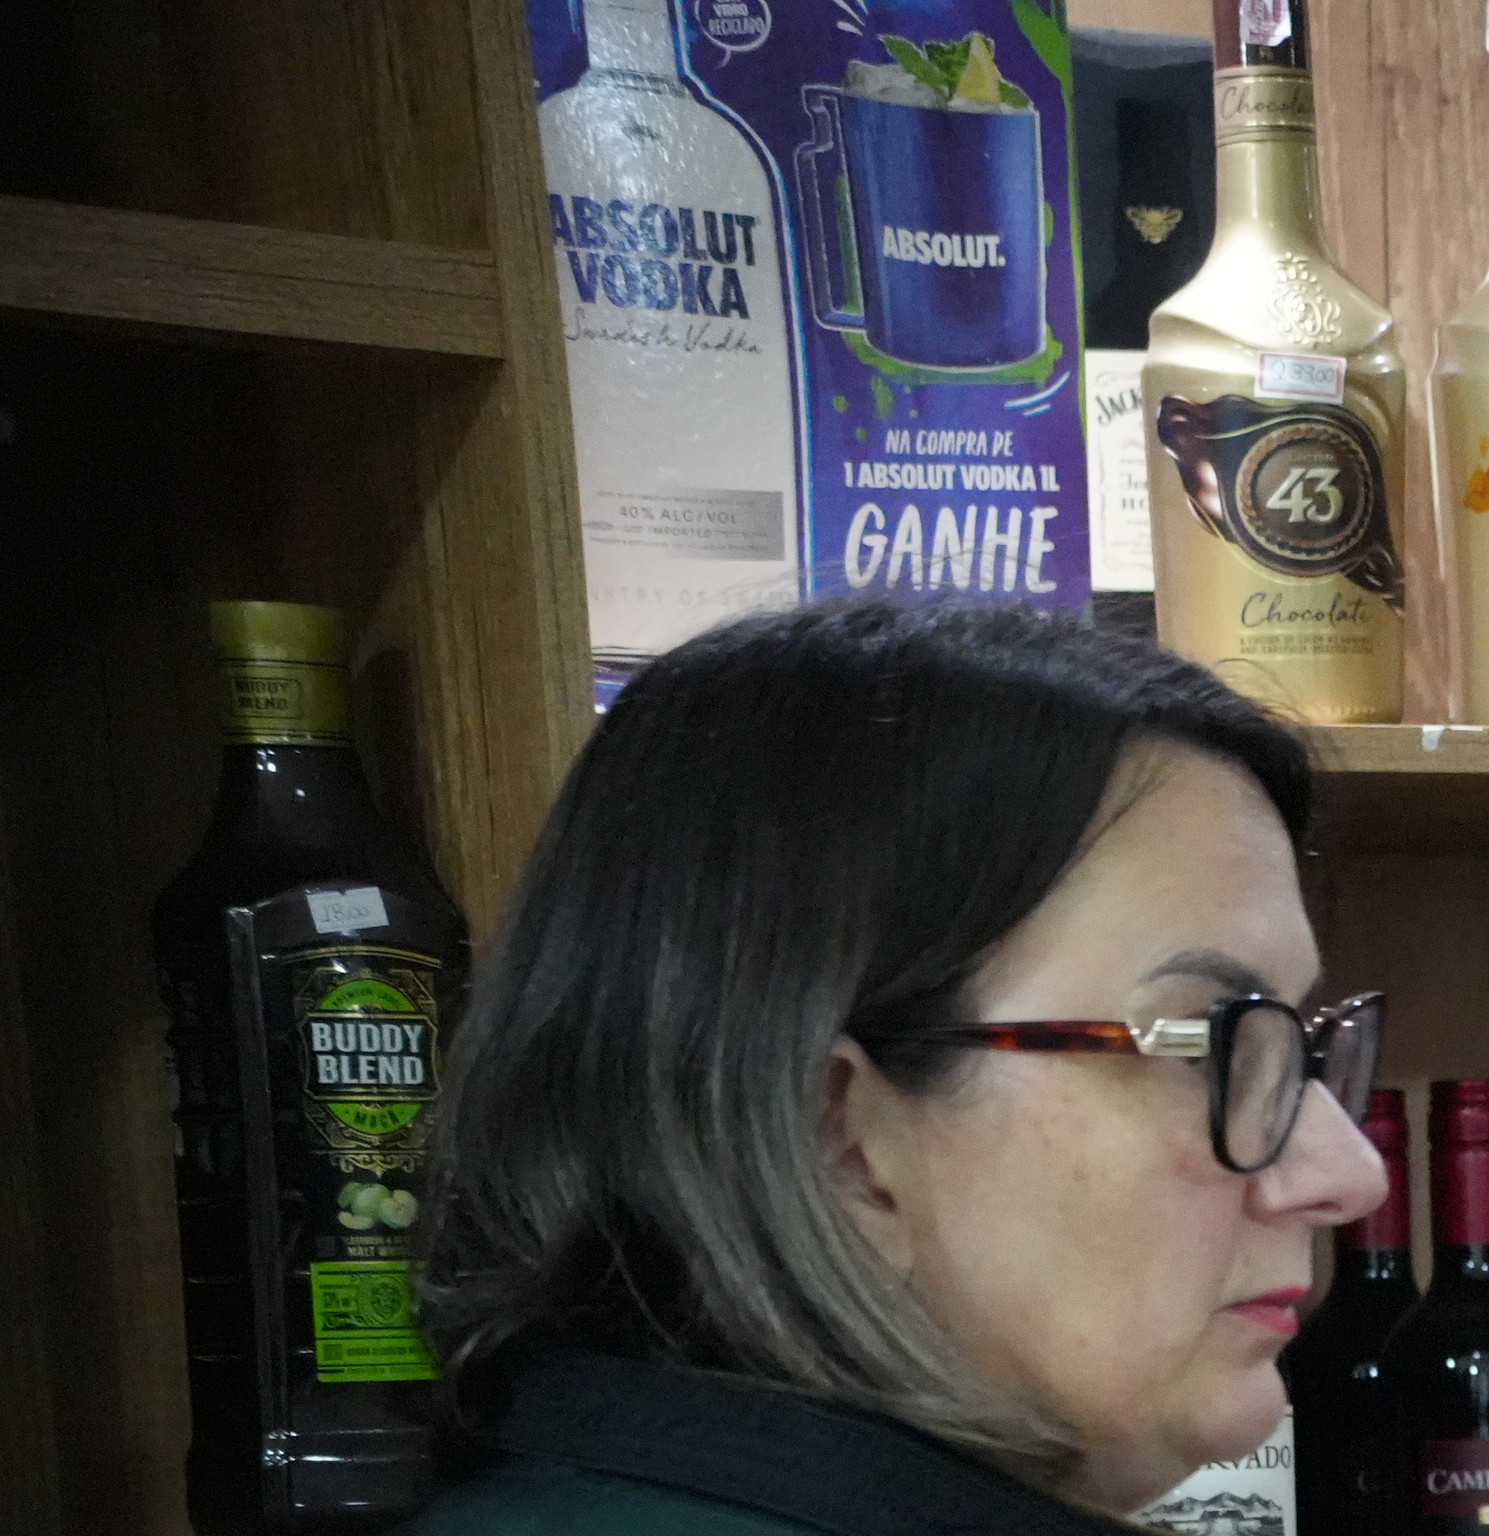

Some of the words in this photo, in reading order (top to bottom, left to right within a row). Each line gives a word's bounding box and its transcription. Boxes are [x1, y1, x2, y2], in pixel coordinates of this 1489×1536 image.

[550, 193, 757, 267] ABSOLUT
[567, 250, 750, 320] VODKA
[885, 429, 911, 454] NA
[915, 429, 988, 457] COMPRA
[857, 462, 957, 491] ABSOLUT
[960, 463, 1038, 492] VODKA
[1265, 467, 1345, 524] 43
[843, 502, 1060, 594] GANHE
[310, 1021, 424, 1053] BUDDY
[316, 1054, 424, 1085] BLEND
